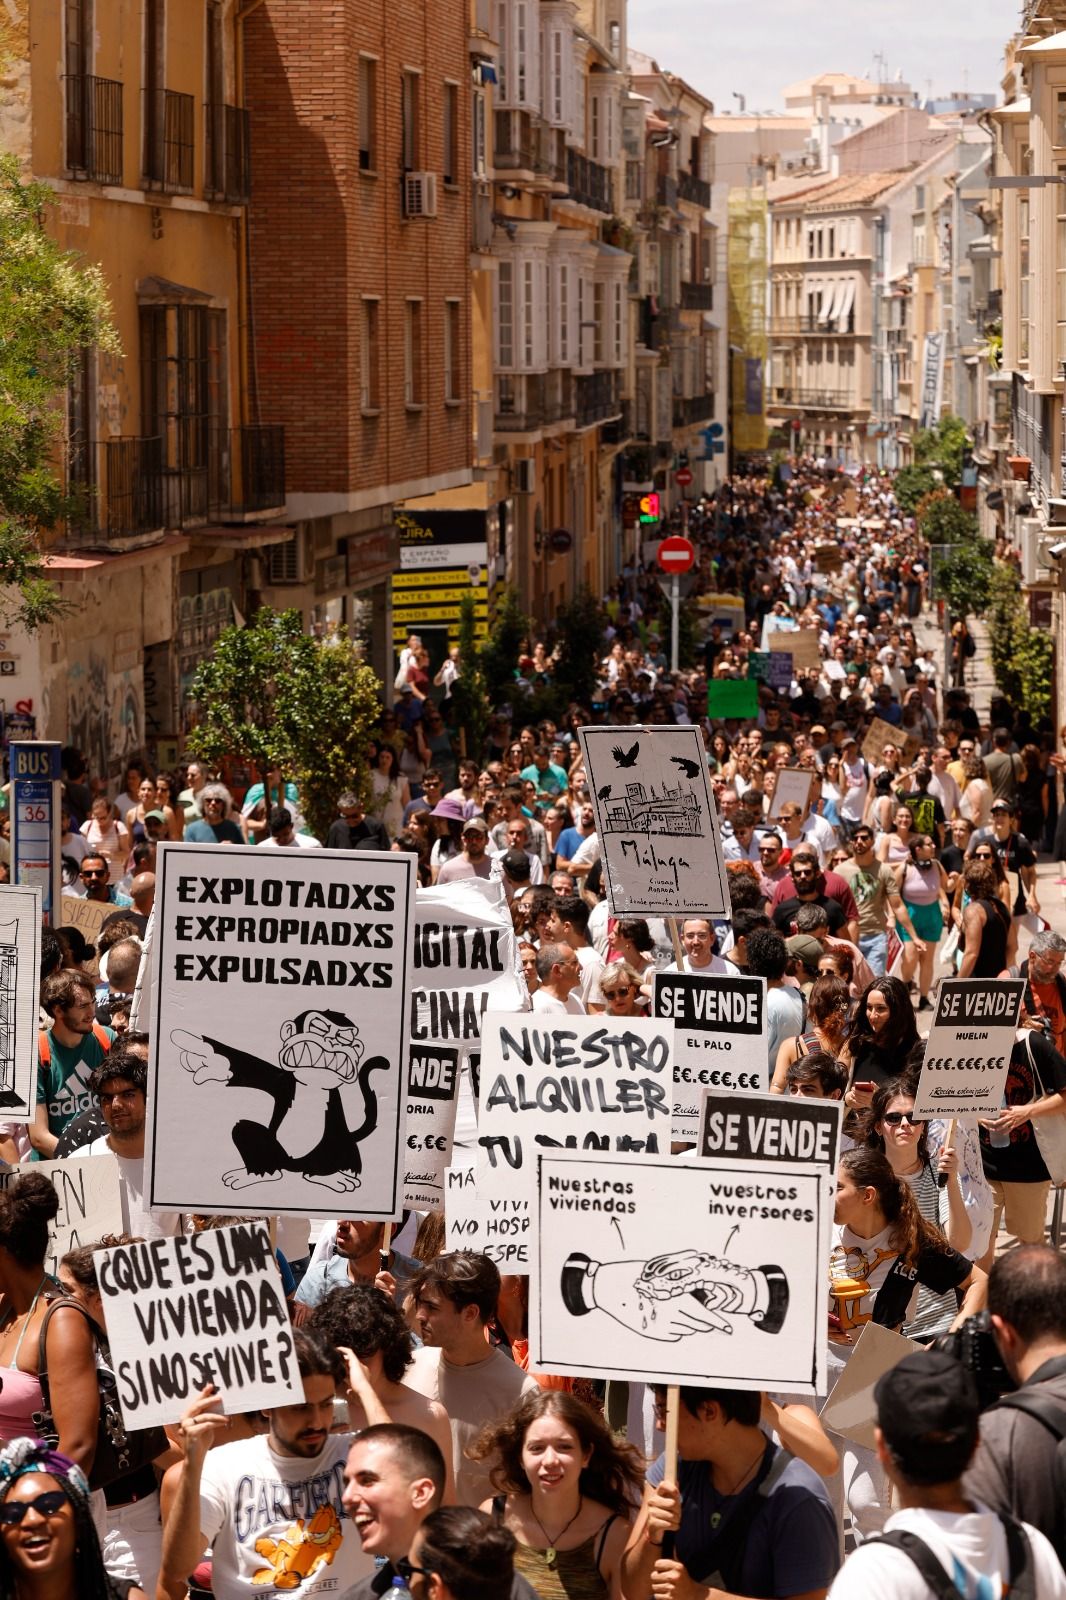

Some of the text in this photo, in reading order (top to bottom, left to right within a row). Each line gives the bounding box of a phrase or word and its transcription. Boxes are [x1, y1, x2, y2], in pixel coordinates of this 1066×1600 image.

[18, 752, 49, 774] BUS
[25, 806, 46, 822] 36
[177, 876, 396, 911] EXPLOTADXS
[175, 915, 394, 948] EXPROPIADXS
[414, 922, 504, 971] IGITAL
[174, 954, 393, 988] EXPULSADXS
[660, 987, 758, 1025] SE VENDE
[940, 992, 1017, 1018] SE VENDE
[500, 1027, 669, 1073] NUESTRO
[687, 1039, 732, 1050] EL PALO
[956, 1032, 988, 1040] HUELIN
[410, 1057, 454, 1090] NDE
[486, 1074, 670, 1120] ALQUILER
[479, 1135, 523, 1169] TU
[708, 1111, 740, 1150] SE
[747, 1116, 831, 1160] VENDE
[549, 1176, 634, 1194] Nuestras
[549, 1197, 636, 1213] viviendas
[709, 1200, 815, 1222] inversores
[451, 1219, 479, 1235] NO
[174, 1233, 215, 1285] ES
[215, 1225, 273, 1277] UNA
[134, 1280, 287, 1346] VIVIENDA
[150, 1353, 189, 1404] NO
